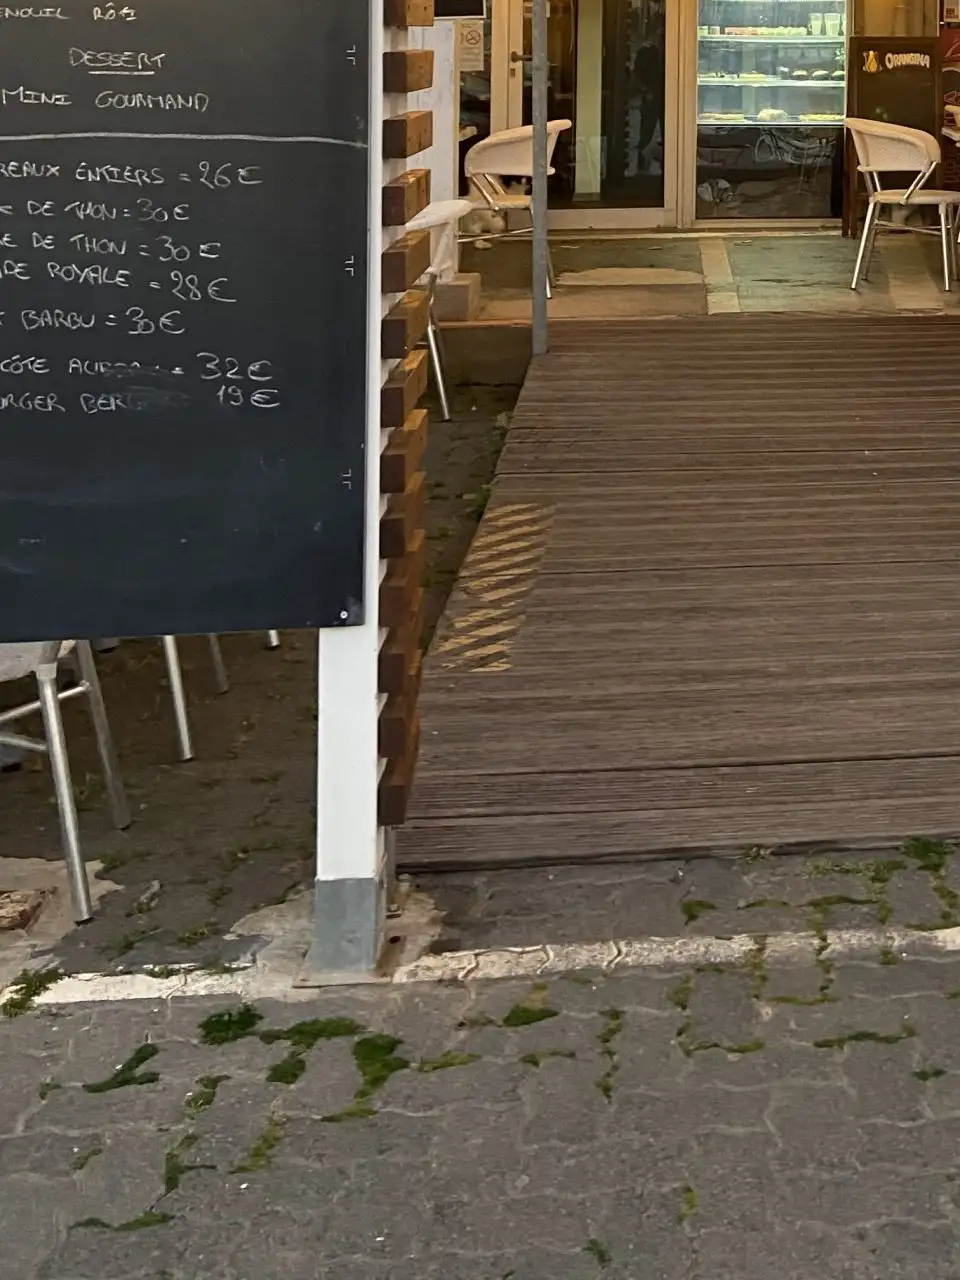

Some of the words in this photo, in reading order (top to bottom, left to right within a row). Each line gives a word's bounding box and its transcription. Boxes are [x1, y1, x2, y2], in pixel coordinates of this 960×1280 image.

[69, 48, 166, 69] DESSERT
[885, 52, 930, 69] ORANGINA
[1, 86, 72, 106] MINI
[95, 91, 209, 112] GOURMAND
[27, 200, 55, 216] DE
[64, 201, 117, 221] THON
[32, 232, 54, 249] DE
[69, 233, 127, 256] THON
[47, 261, 131, 288] ROYALE
[21, 309, 95, 331] BARBU
